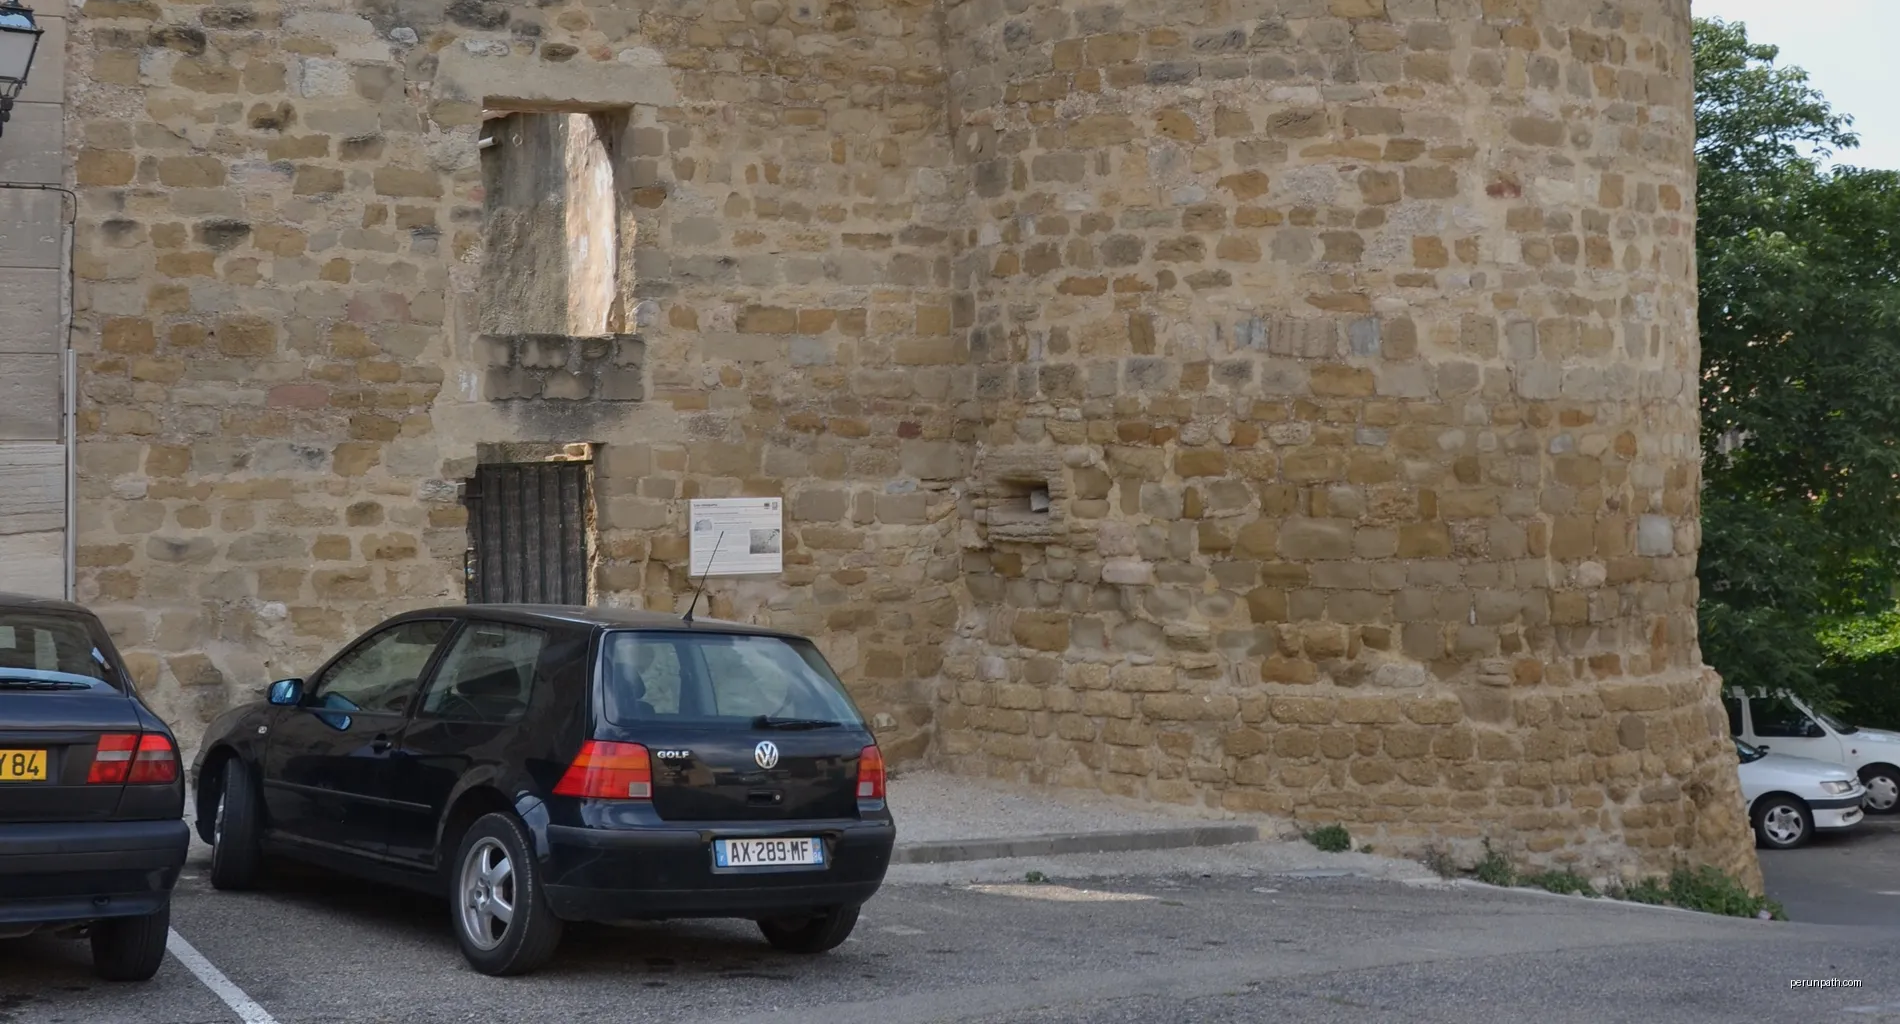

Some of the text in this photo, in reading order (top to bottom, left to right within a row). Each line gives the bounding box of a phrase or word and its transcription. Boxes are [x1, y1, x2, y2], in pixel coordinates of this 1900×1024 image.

[12, 753, 39, 776] 84
[656, 750, 690, 759] GOLF
[731, 841, 808, 863] AX-289-MF
